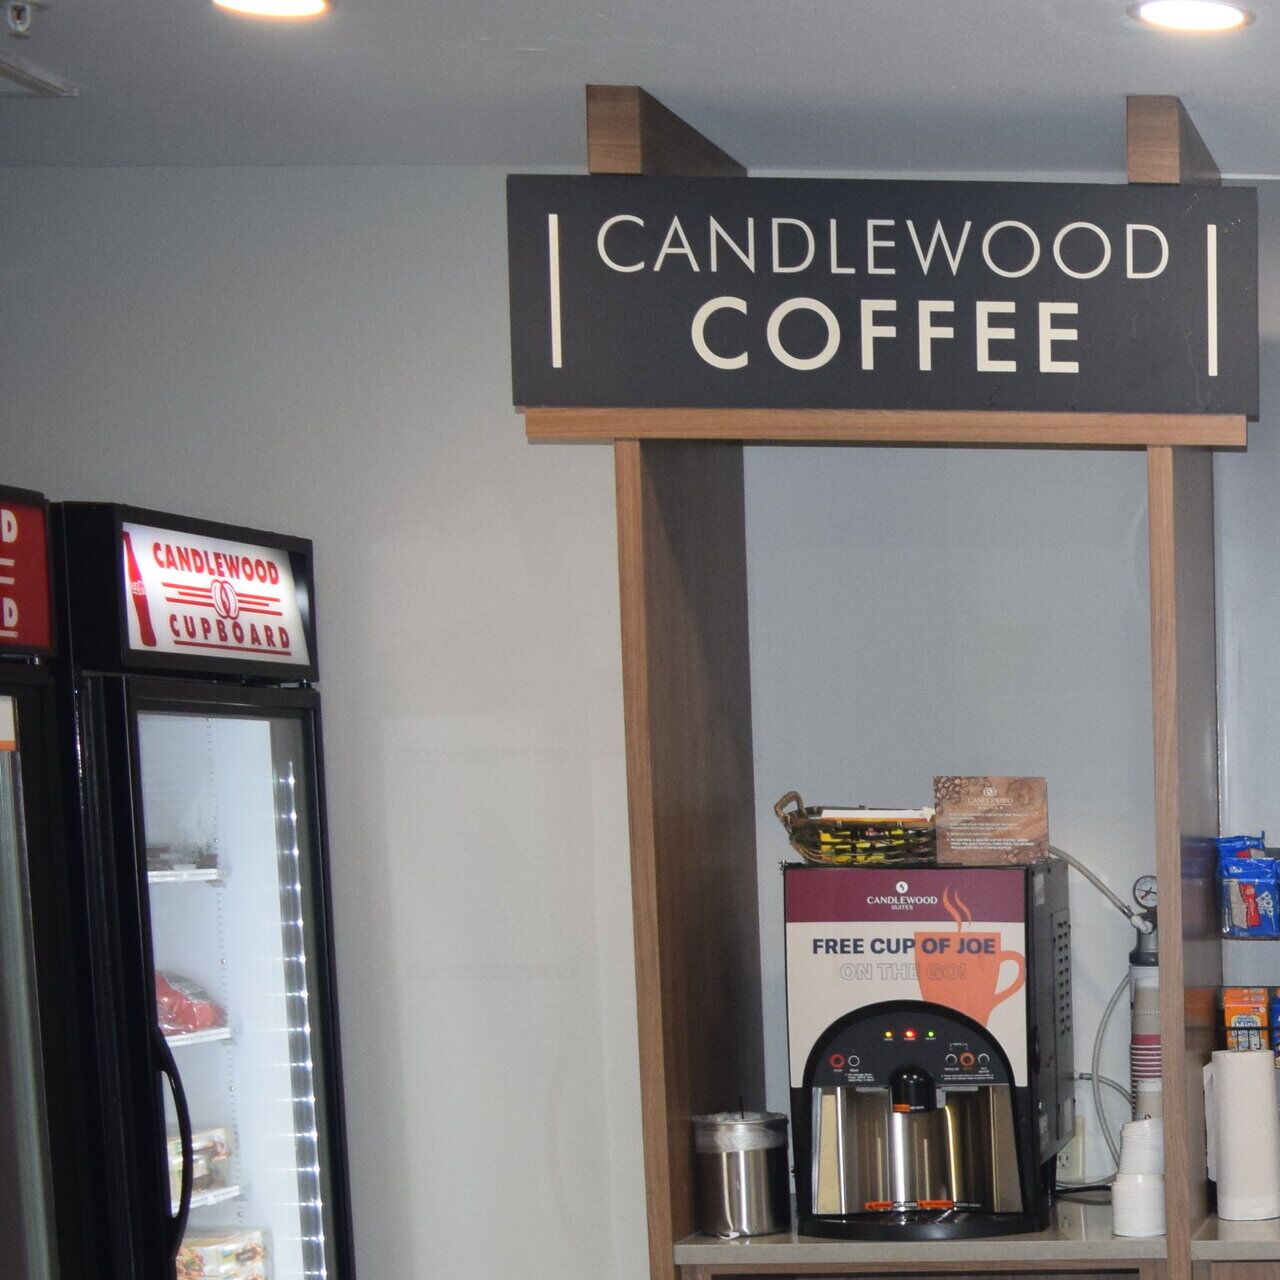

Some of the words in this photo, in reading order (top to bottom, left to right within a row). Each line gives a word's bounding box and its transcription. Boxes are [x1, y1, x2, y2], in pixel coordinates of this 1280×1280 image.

[597, 214, 1170, 280] CANDLEWOOD
[690, 296, 1080, 374] COFFEE
[152, 542, 280, 585] CANDLEWOOD
[169, 613, 290, 649] CUPBOARD
[867, 896, 938, 905] CANDLEWOOD
[812, 938, 864, 955] FREE
[870, 938, 916, 955] CUP
[921, 938, 950, 954] OF
[957, 938, 996, 954] JOE
[840, 963, 873, 980] ON
[877, 963, 920, 980] THE
[926, 963, 967, 980] GO!
